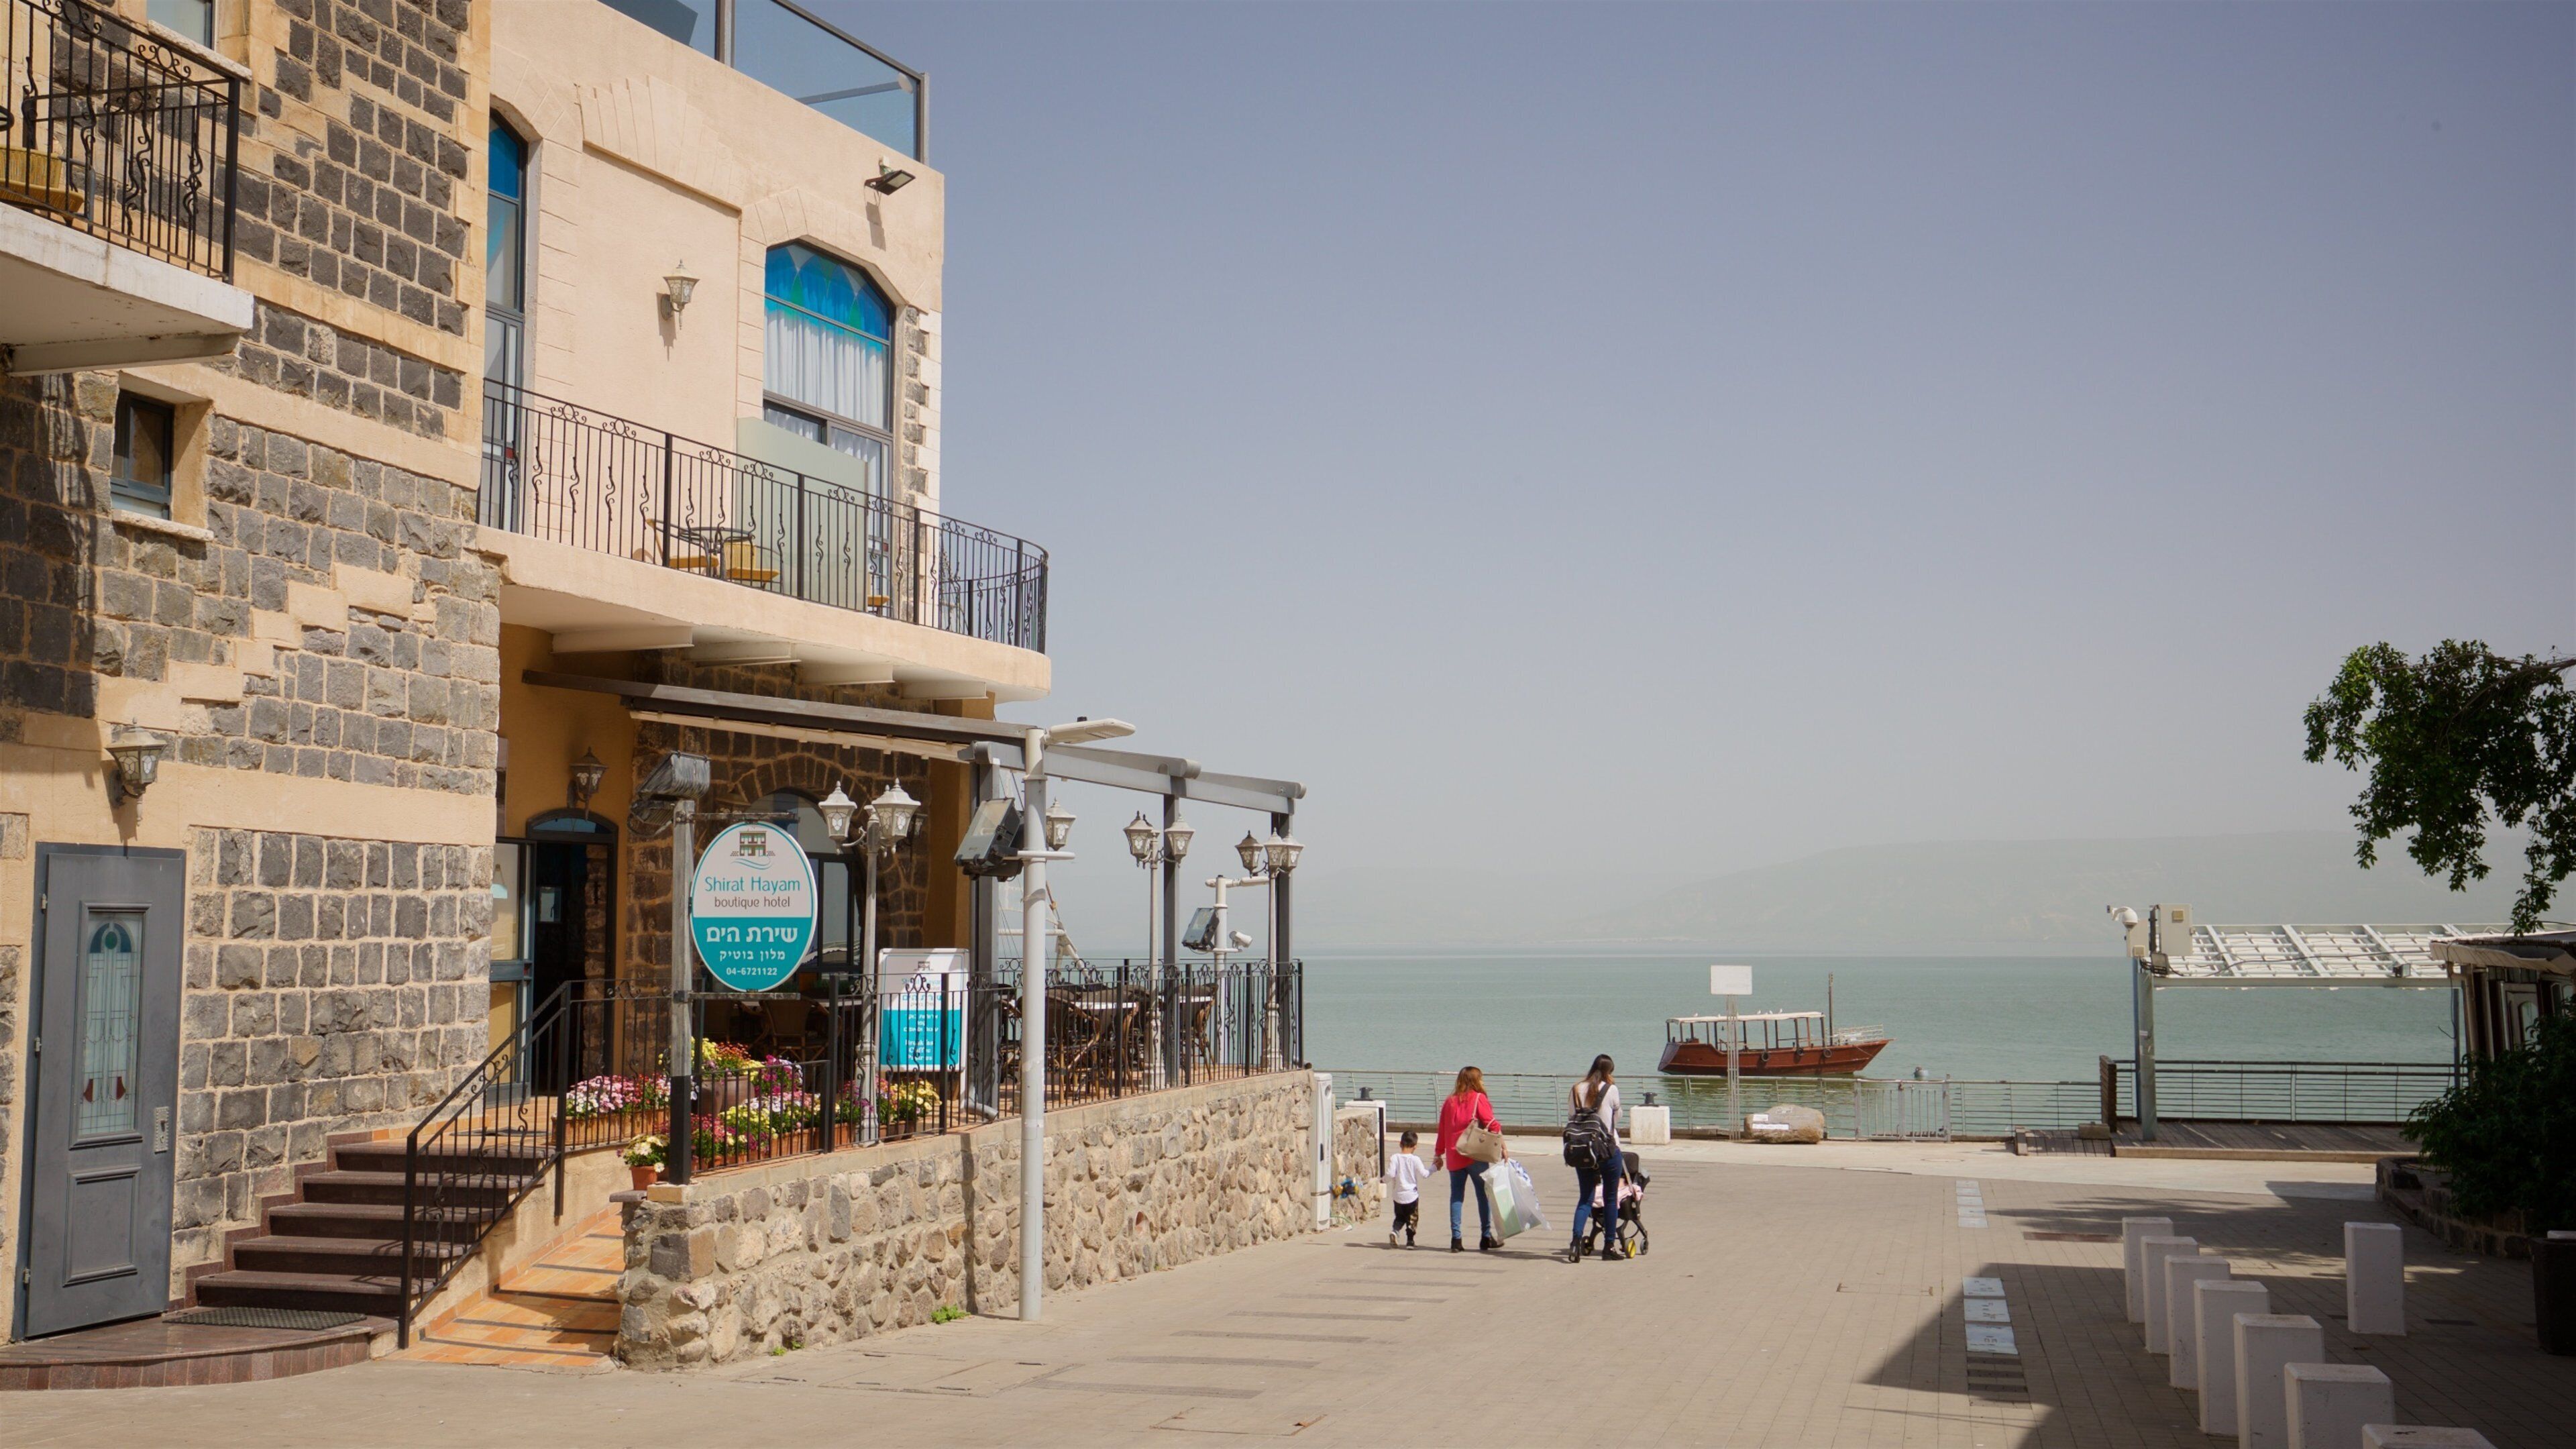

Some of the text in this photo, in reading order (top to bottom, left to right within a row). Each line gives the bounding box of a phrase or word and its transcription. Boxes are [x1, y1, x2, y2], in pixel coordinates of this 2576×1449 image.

[704, 876, 800, 894] Shirat Hayam
[714, 896, 790, 909] boutique hotel
[706, 926, 798, 943] שירת הים
[719, 948, 786, 961] מלון בוטיק
[726, 967, 777, 976] 04-6721122
